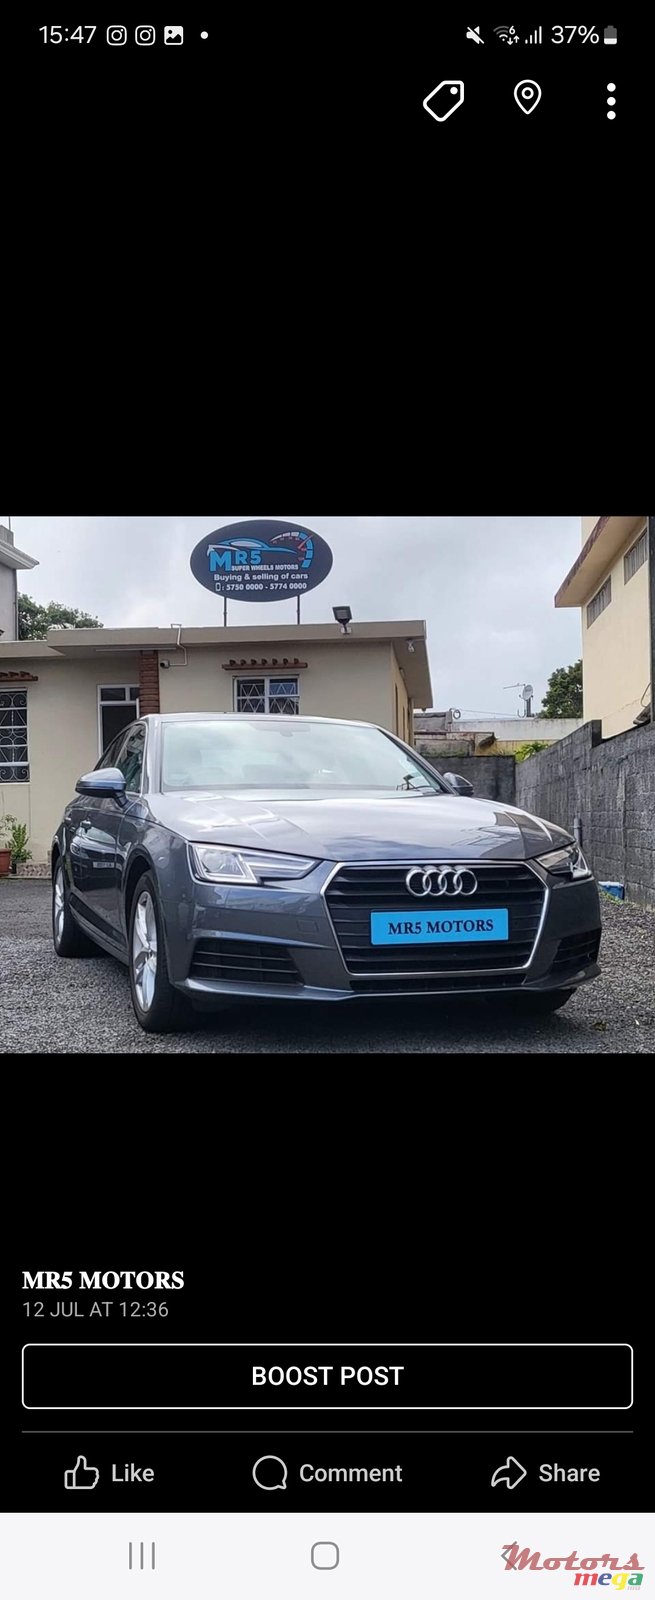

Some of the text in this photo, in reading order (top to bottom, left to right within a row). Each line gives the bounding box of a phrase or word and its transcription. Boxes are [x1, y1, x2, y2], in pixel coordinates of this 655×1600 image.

[210, 550, 262, 572] MR5
[213, 573, 242, 582] Buying
[252, 572, 279, 582] selling
[281, 572, 290, 580] of
[226, 583, 244, 591] 5750
[245, 583, 264, 591] 0000
[289, 582, 308, 590] 0000
[388, 918, 495, 935] MR5 MOTORS
